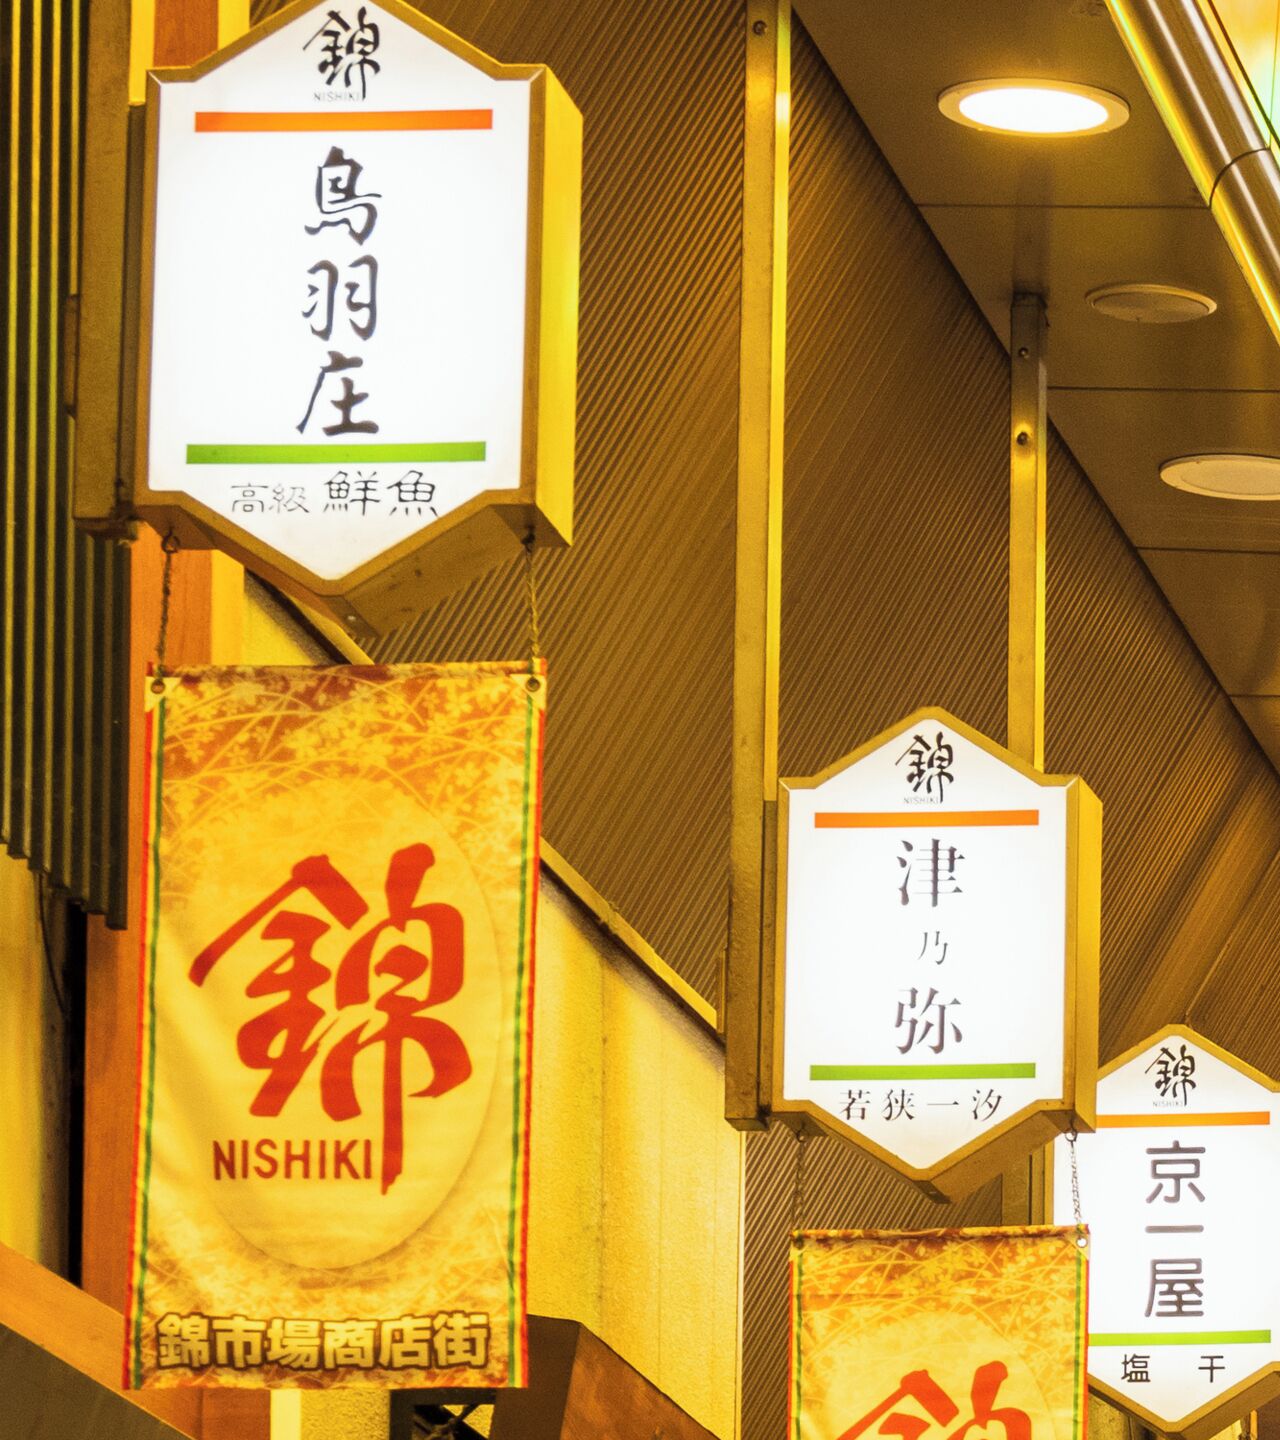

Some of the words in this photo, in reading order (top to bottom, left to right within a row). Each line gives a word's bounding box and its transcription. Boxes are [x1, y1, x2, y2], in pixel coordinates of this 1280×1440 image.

[303, 7, 381, 99] 錦
[313, 92, 362, 102] NISHIKI
[231, 471, 439, 517] 高級鮮魚
[895, 732, 954, 803] 錦
[895, 838, 965, 1056] 津乃弥
[189, 842, 472, 1195] 錦
[838, 1088, 1002, 1122] 若狭一汐
[1144, 1044, 1196, 1106] 錦
[212, 1138, 374, 1182] NISHIKI
[1144, 1140, 1206, 1319] 京一屋
[156, 1311, 491, 1371] 錦市場商店街
[1121, 1353, 1226, 1385] 塩干
